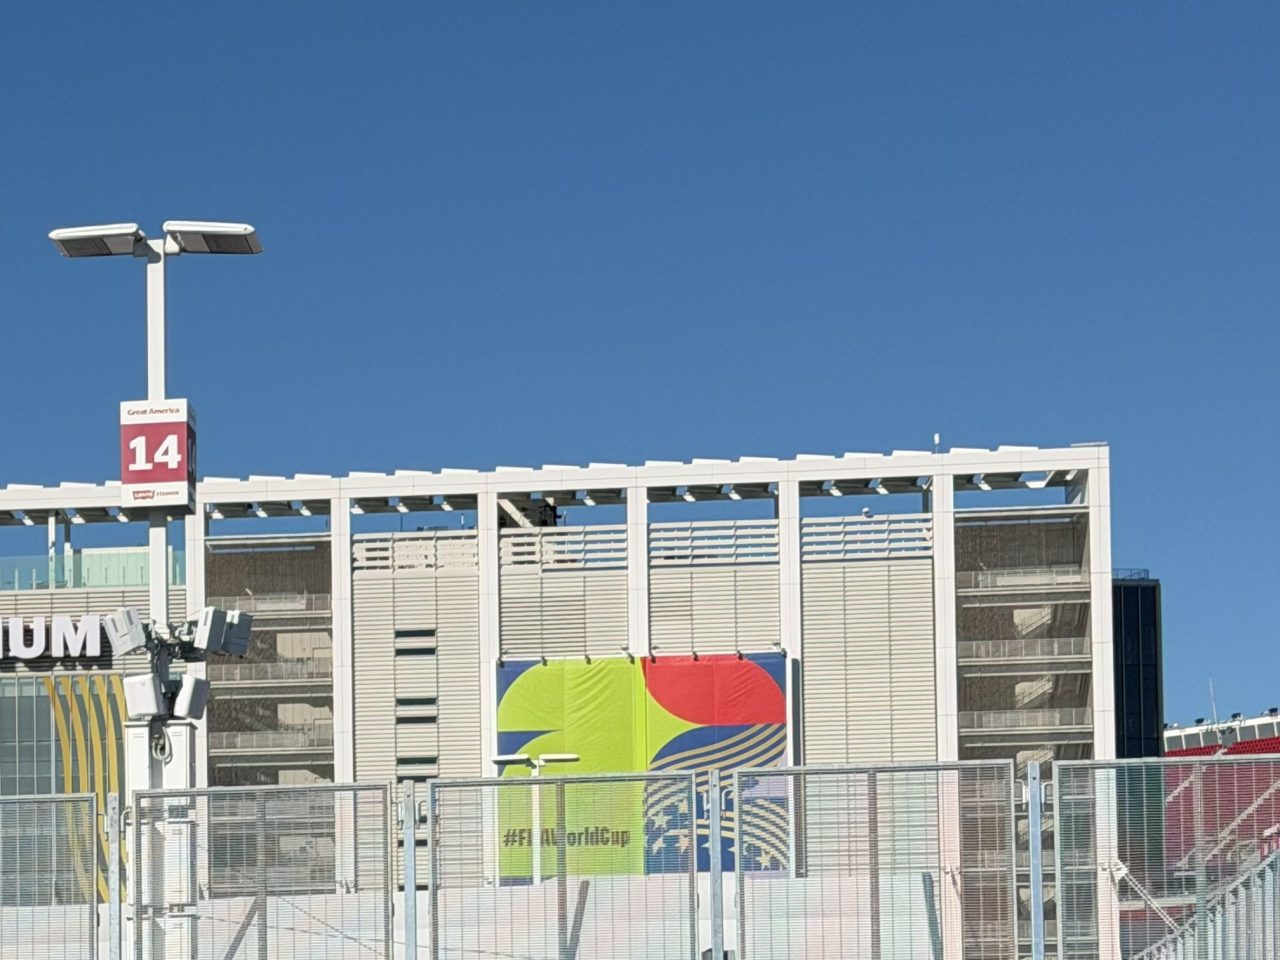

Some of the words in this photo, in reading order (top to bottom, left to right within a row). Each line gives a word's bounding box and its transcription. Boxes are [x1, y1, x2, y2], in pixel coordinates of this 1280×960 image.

[127, 408, 147, 416] Great
[148, 407, 180, 415] America
[128, 434, 182, 471] 14
[503, 825, 631, 848] #FIAorldCup
